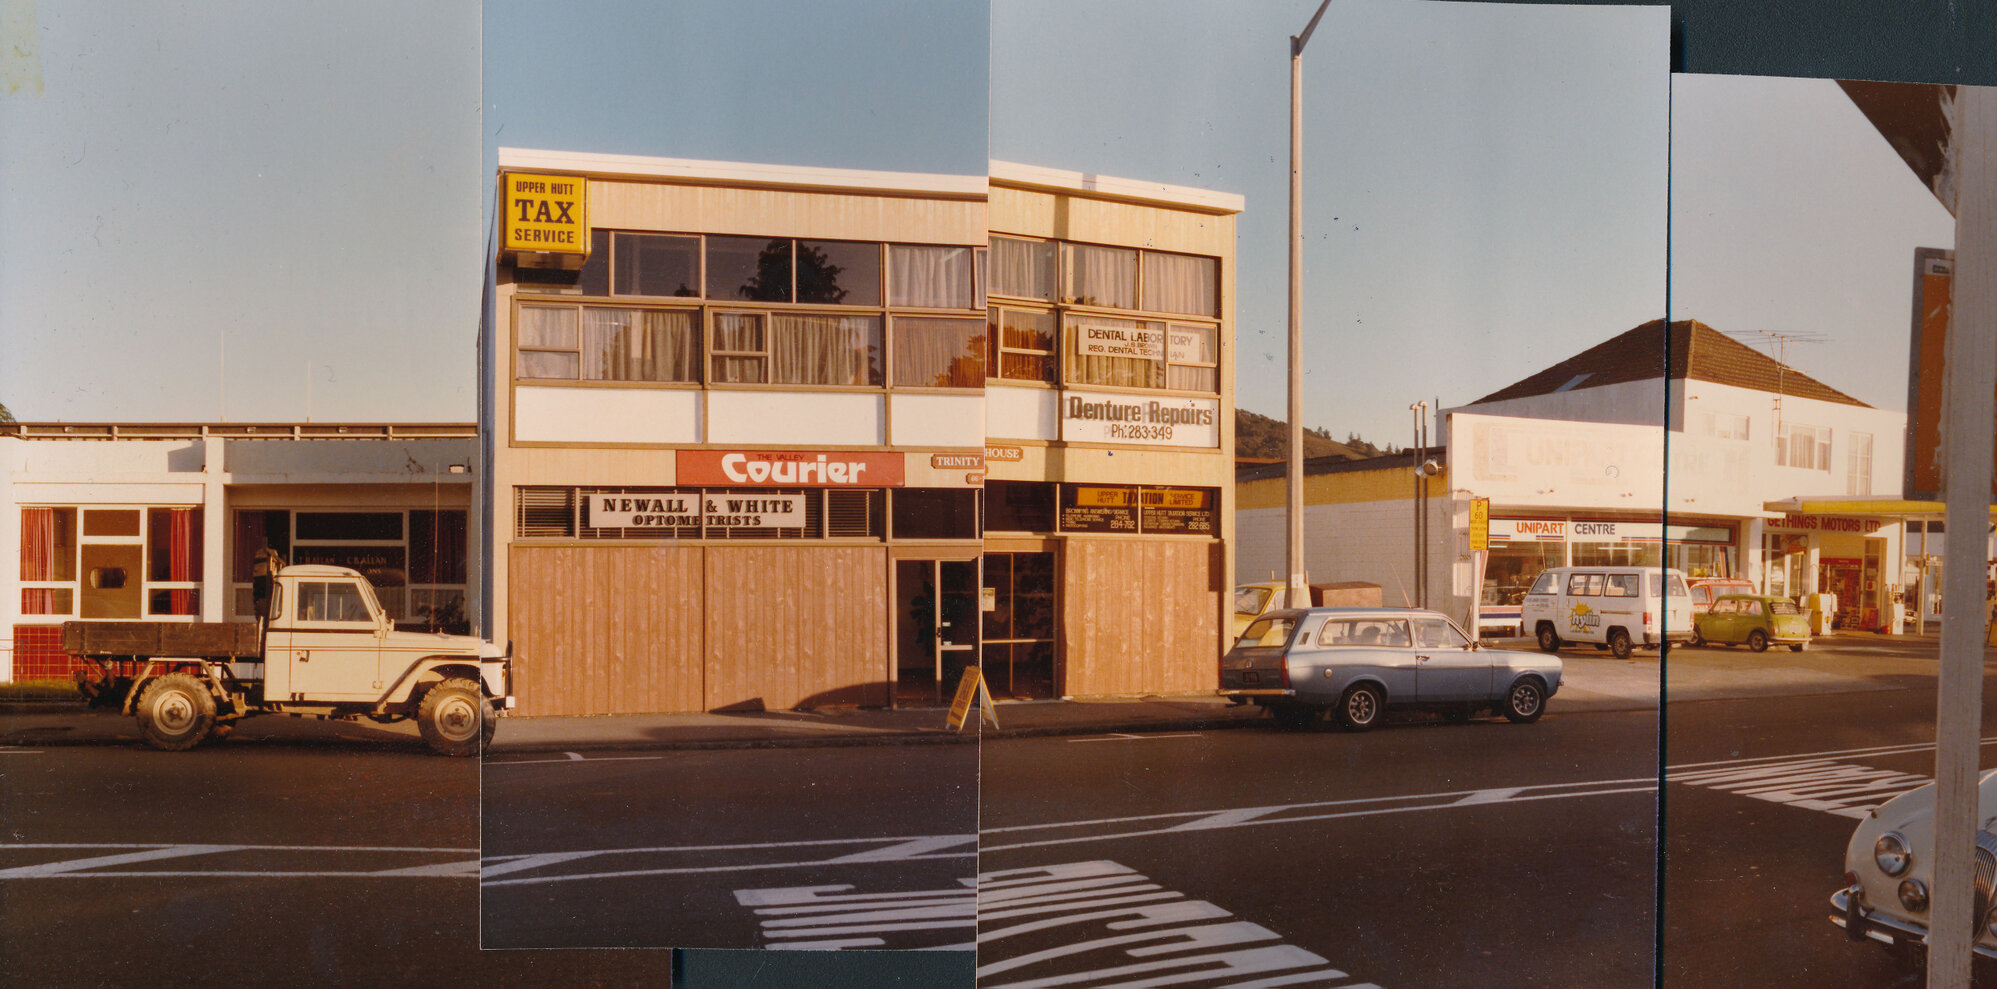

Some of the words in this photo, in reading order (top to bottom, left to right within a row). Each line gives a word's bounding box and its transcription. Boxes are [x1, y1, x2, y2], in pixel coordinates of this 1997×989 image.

[516, 181, 546, 194] UPPER
[551, 183, 574, 195] HUTT
[514, 199, 574, 224] TAX
[514, 228, 574, 244] SERVICE
[1088, 328, 1127, 341] DENTAL
[1130, 333, 1193, 346] LABORTORY
[1088, 344, 1106, 353] REG.
[1108, 346, 1138, 355] DENTAL
[1069, 396, 1141, 422] Denture
[1149, 400, 1213, 426] Repairs
[775, 454, 805, 462] VALLEY
[936, 456, 979, 466] TRINITY
[985, 448, 1019, 458] HOUSE
[721, 453, 866, 483] Courier
[603, 498, 688, 514] NEWALL
[706, 500, 718, 513] &
[727, 500, 793, 514] WHITE
[1476, 501, 1482, 510] P
[632, 514, 762, 526] OPTOMETRISTS
[1820, 517, 1861, 532] MOTORS
[1516, 522, 1564, 535] UNIPART
[1574, 522, 1616, 536] CENTRE
[1571, 611, 1600, 628] hylin
